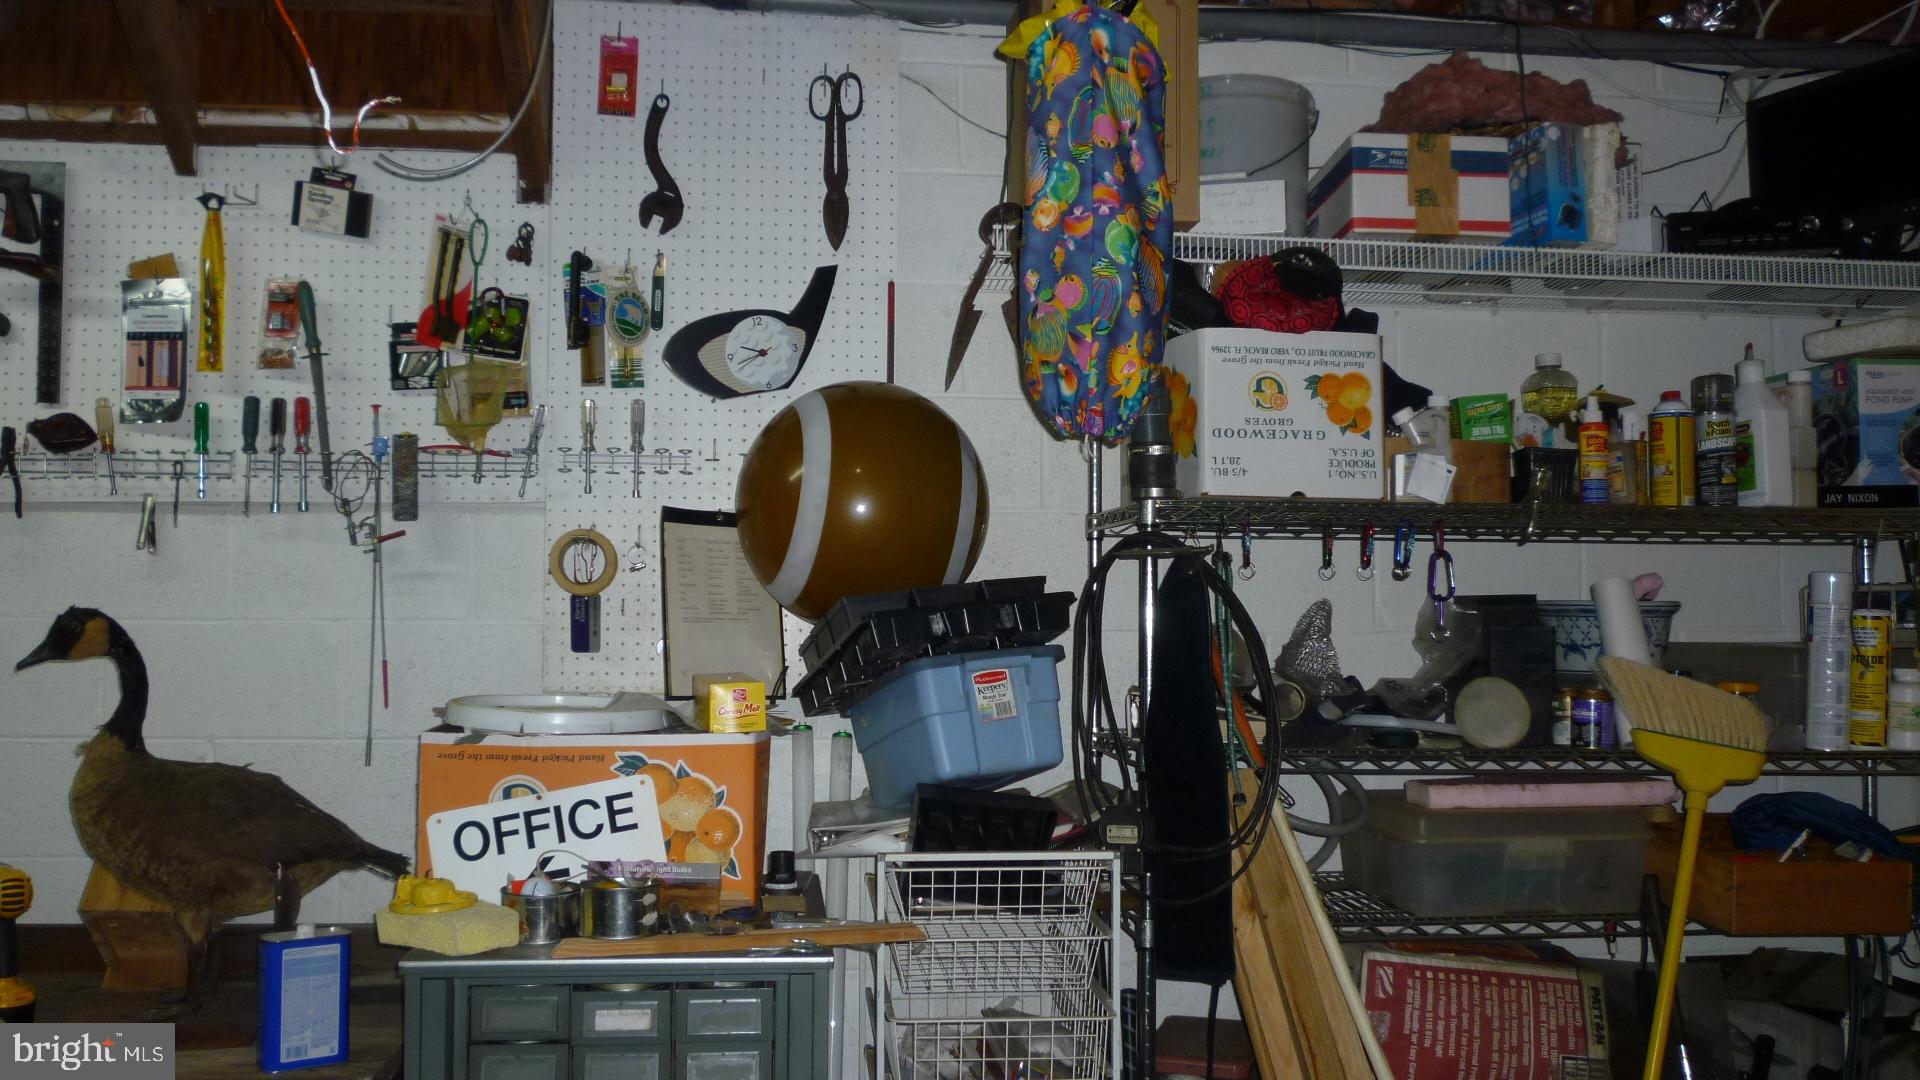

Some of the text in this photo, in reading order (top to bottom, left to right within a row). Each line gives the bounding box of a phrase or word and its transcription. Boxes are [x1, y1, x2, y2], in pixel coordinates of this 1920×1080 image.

[752, 317, 762, 326] 12
[792, 343, 798, 352] 3
[1211, 345, 1232, 354] 32966
[1233, 346, 1242, 354] FL
[1243, 346, 1269, 355] BEACH,
[1270, 348, 1290, 356] VERO
[1308, 349, 1328, 357] FRUIT
[1329, 350, 1376, 359] GRACEWOOD
[727, 353, 733, 363] 9
[1265, 358, 1285, 366] from
[1287, 359, 1310, 367] Fresh
[1313, 360, 1341, 368] Picked
[1343, 361, 1365, 369] Hand
[766, 381, 771, 389] 6
[1244, 417, 1294, 426] GROVES
[1706, 419, 1731, 429] Touch
[1212, 428, 1326, 440] GRACEWOOD
[1710, 428, 1731, 437] Foam
[1361, 449, 1375, 457] OF
[1212, 457, 1241, 465] 28.1 L
[1328, 459, 1376, 468] PRODUCE
[1232, 468, 1248, 477] 4/5
[1358, 471, 1377, 479] U.S.
[1824, 493, 1879, 504] JAY NIXON
[743, 703, 761, 714] Melt
[466, 753, 482, 761] the
[485, 753, 508, 762] from
[511, 754, 538, 762] Fresh
[541, 755, 575, 763] Picked
[578, 755, 605, 763] Hand
[453, 792, 638, 861] OFFICE
[1403, 1004, 1412, 1034] Mounting
[1591, 986, 1605, 1045] PATTON
[1411, 1010, 1420, 1031] Handle
[1437, 1020, 1445, 1040] Signal
[1566, 1004, 1575, 1049] Construction
[1449, 1018, 1457, 1056] Thermostat
[1540, 1024, 1549, 1058] Favorite!
[1550, 1033, 1558, 1048] this
[1409, 1045, 1417, 1061] Easy
[1435, 1042, 1443, 1058] Light
[1460, 1033, 1468, 1069] Fan-Forced
[1472, 1039, 1480, 1065] Thermal
